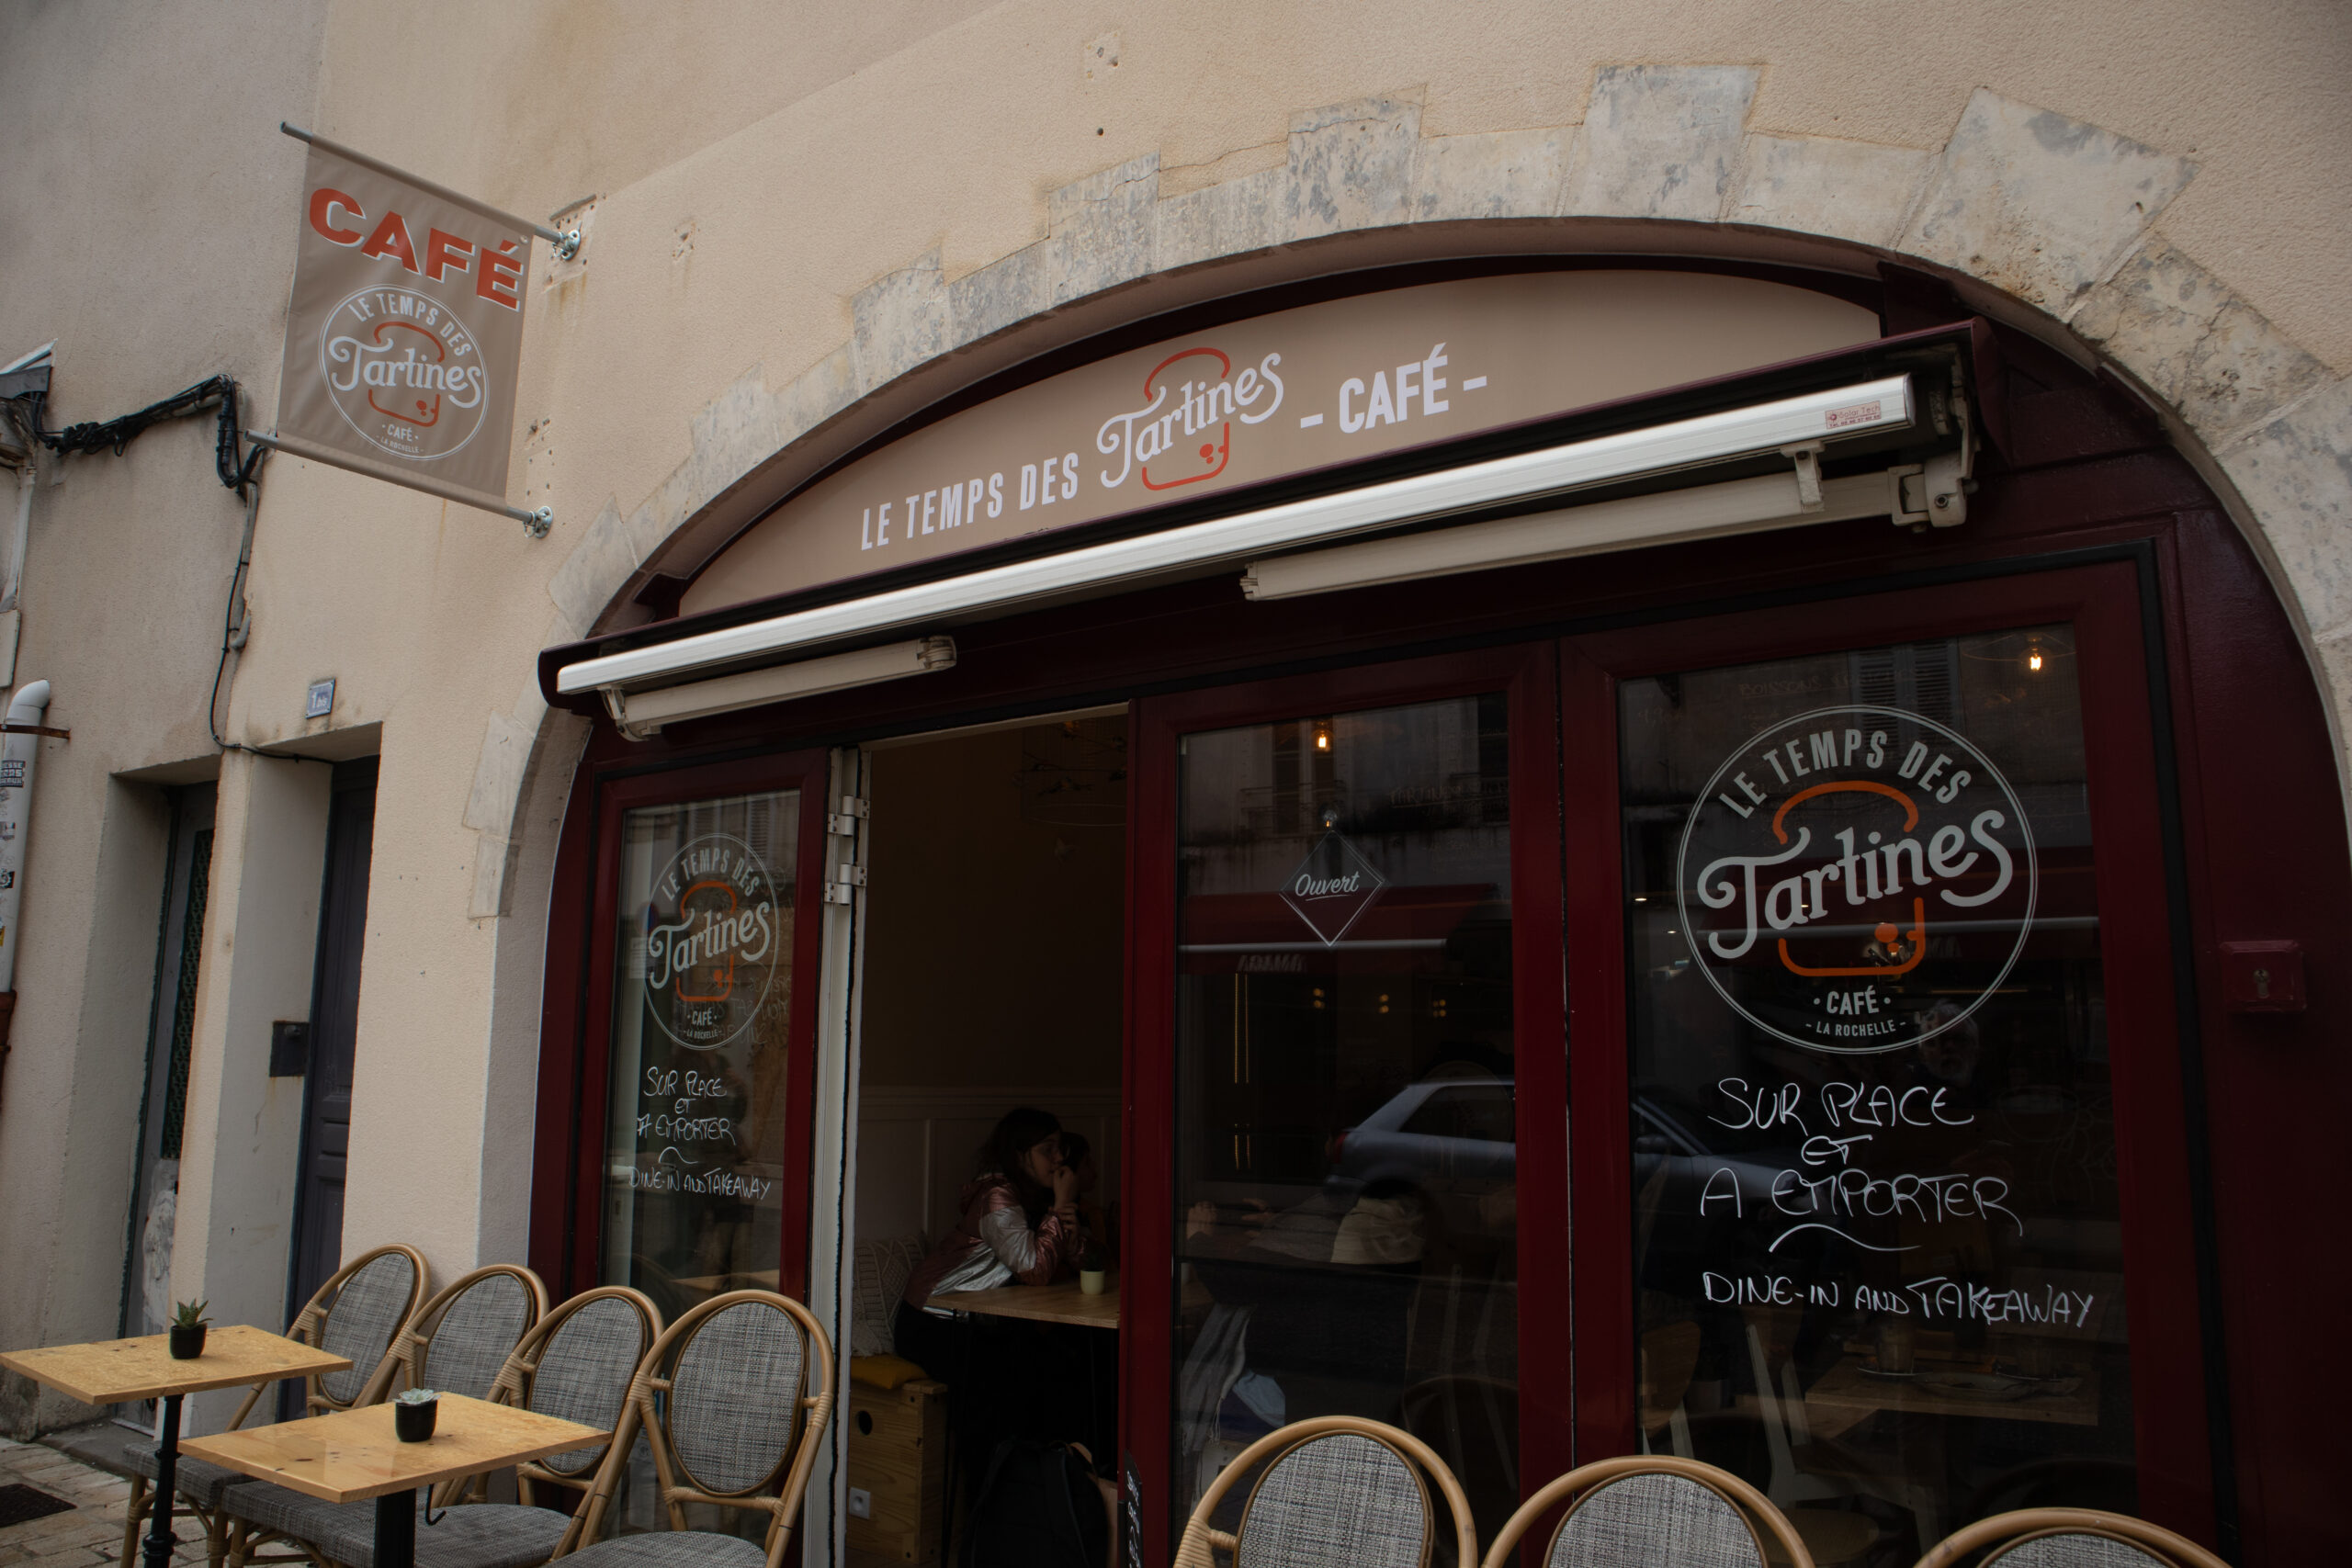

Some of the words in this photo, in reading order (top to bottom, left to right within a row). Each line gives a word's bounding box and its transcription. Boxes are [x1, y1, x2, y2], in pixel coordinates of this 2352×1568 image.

[309, 187, 525, 312] CAFÉ
[348, 298, 375, 321] LE
[376, 293, 439, 326] TEMPS
[439, 321, 472, 356] DES
[329, 336, 481, 409] Tartines
[380, 436, 389, 446] LA
[390, 441, 419, 454] ROCHELLE
[387, 423, 413, 442] CAFÉ
[861, 502, 891, 551] LE
[905, 472, 1004, 539] TEMPS
[1019, 452, 1080, 512] DES
[1096, 352, 1284, 488] Tartines
[1339, 342, 1450, 434] CAFÉ
[1719, 772, 1768, 818] LE
[1762, 728, 1888, 785] TEMPS
[1897, 740, 1972, 804] DES
[662, 874, 681, 901] LE
[681, 847, 729, 881] TEMPS
[732, 857, 760, 897] DES
[1295, 870, 1360, 897] Ouvert
[1697, 809, 2014, 959] Tartines
[649, 901, 770, 989] Tartines
[692, 1008, 714, 1026] CAFÉ
[1826, 985, 1879, 1015] CAFÉ
[1816, 1021, 1831, 1035] LA
[1835, 1020, 1896, 1037] ROCHELLE
[643, 1066, 678, 1097] SUR
[685, 1070, 728, 1098] PLACE
[674, 1098, 697, 1114] ET
[1707, 1077, 1808, 1136] SUR
[1821, 1081, 1974, 1128] PLACE
[655, 1114, 737, 1146] EMPORTER
[1802, 1134, 1873, 1166] ET
[629, 1166, 680, 1192] DINE-IN
[684, 1174, 707, 1194] AND
[703, 1167, 771, 1201] TAKEAWAY
[1700, 1168, 1742, 1218] A
[1771, 1168, 2022, 1237] EMPORTER
[1702, 1271, 1838, 1306] DINE-IN
[1854, 1285, 1910, 1314] AND
[1905, 1277, 2095, 1328] TAKEAWAY
